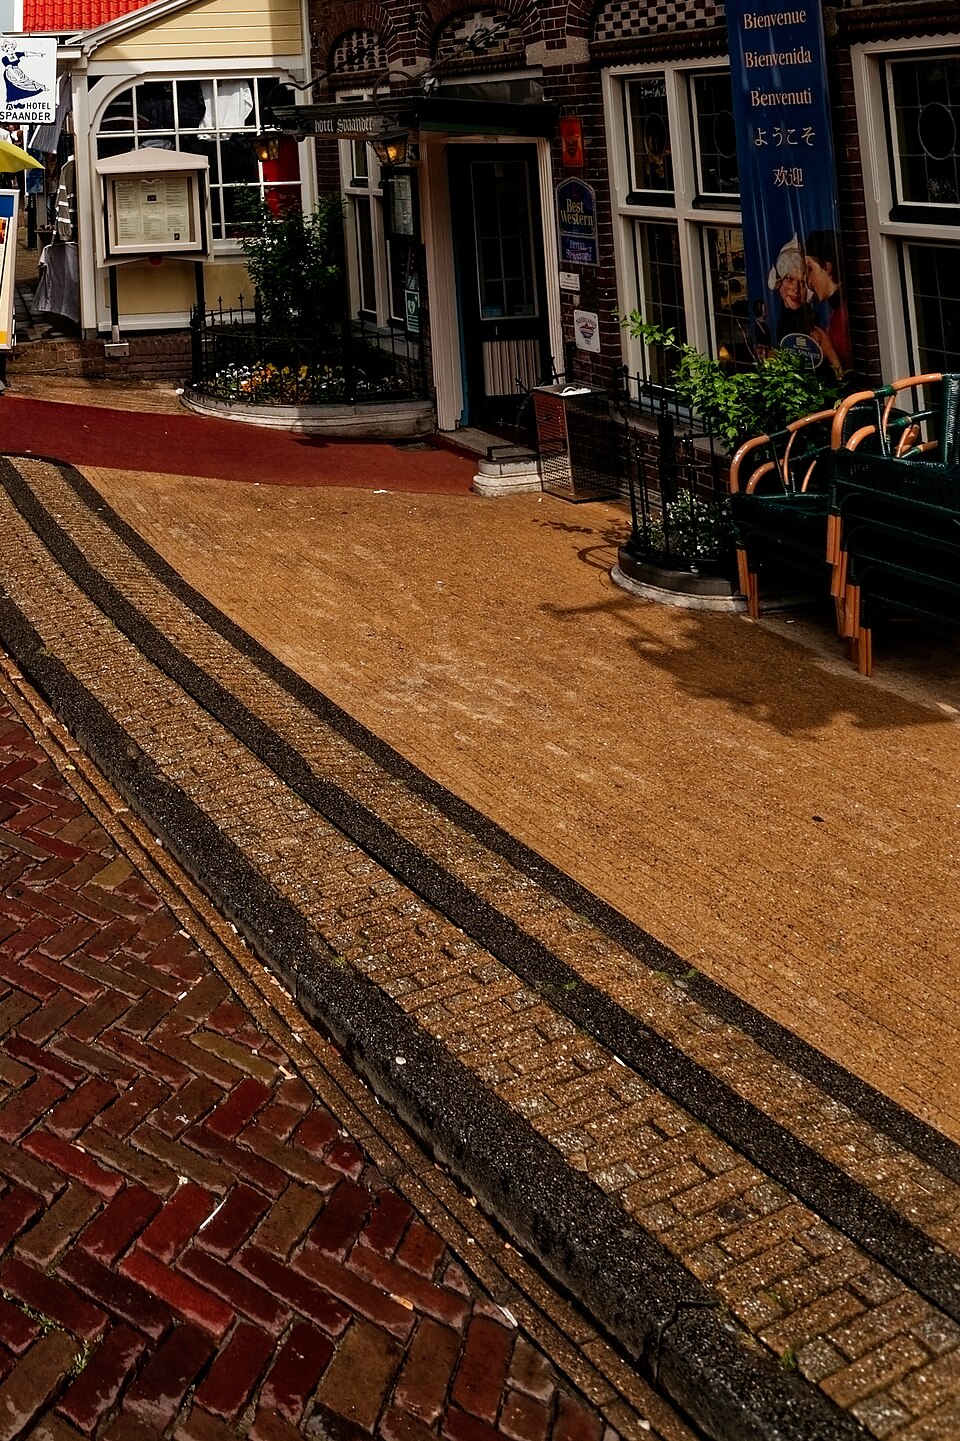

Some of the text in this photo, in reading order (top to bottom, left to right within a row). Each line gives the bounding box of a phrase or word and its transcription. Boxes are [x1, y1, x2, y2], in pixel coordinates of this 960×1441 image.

[743, 9, 807, 30] Bienvenue
[745, 46, 812, 68] Bienvenida
[26, 102, 52, 110] HOTEL
[751, 87, 812, 107] Benvenuti
[0, 111, 51, 121] SPAANDER
[754, 126, 816, 147] ようこそ
[773, 165, 804, 188] 欢迎
[566, 198, 584, 214] Best
[560, 209, 594, 227] Western
